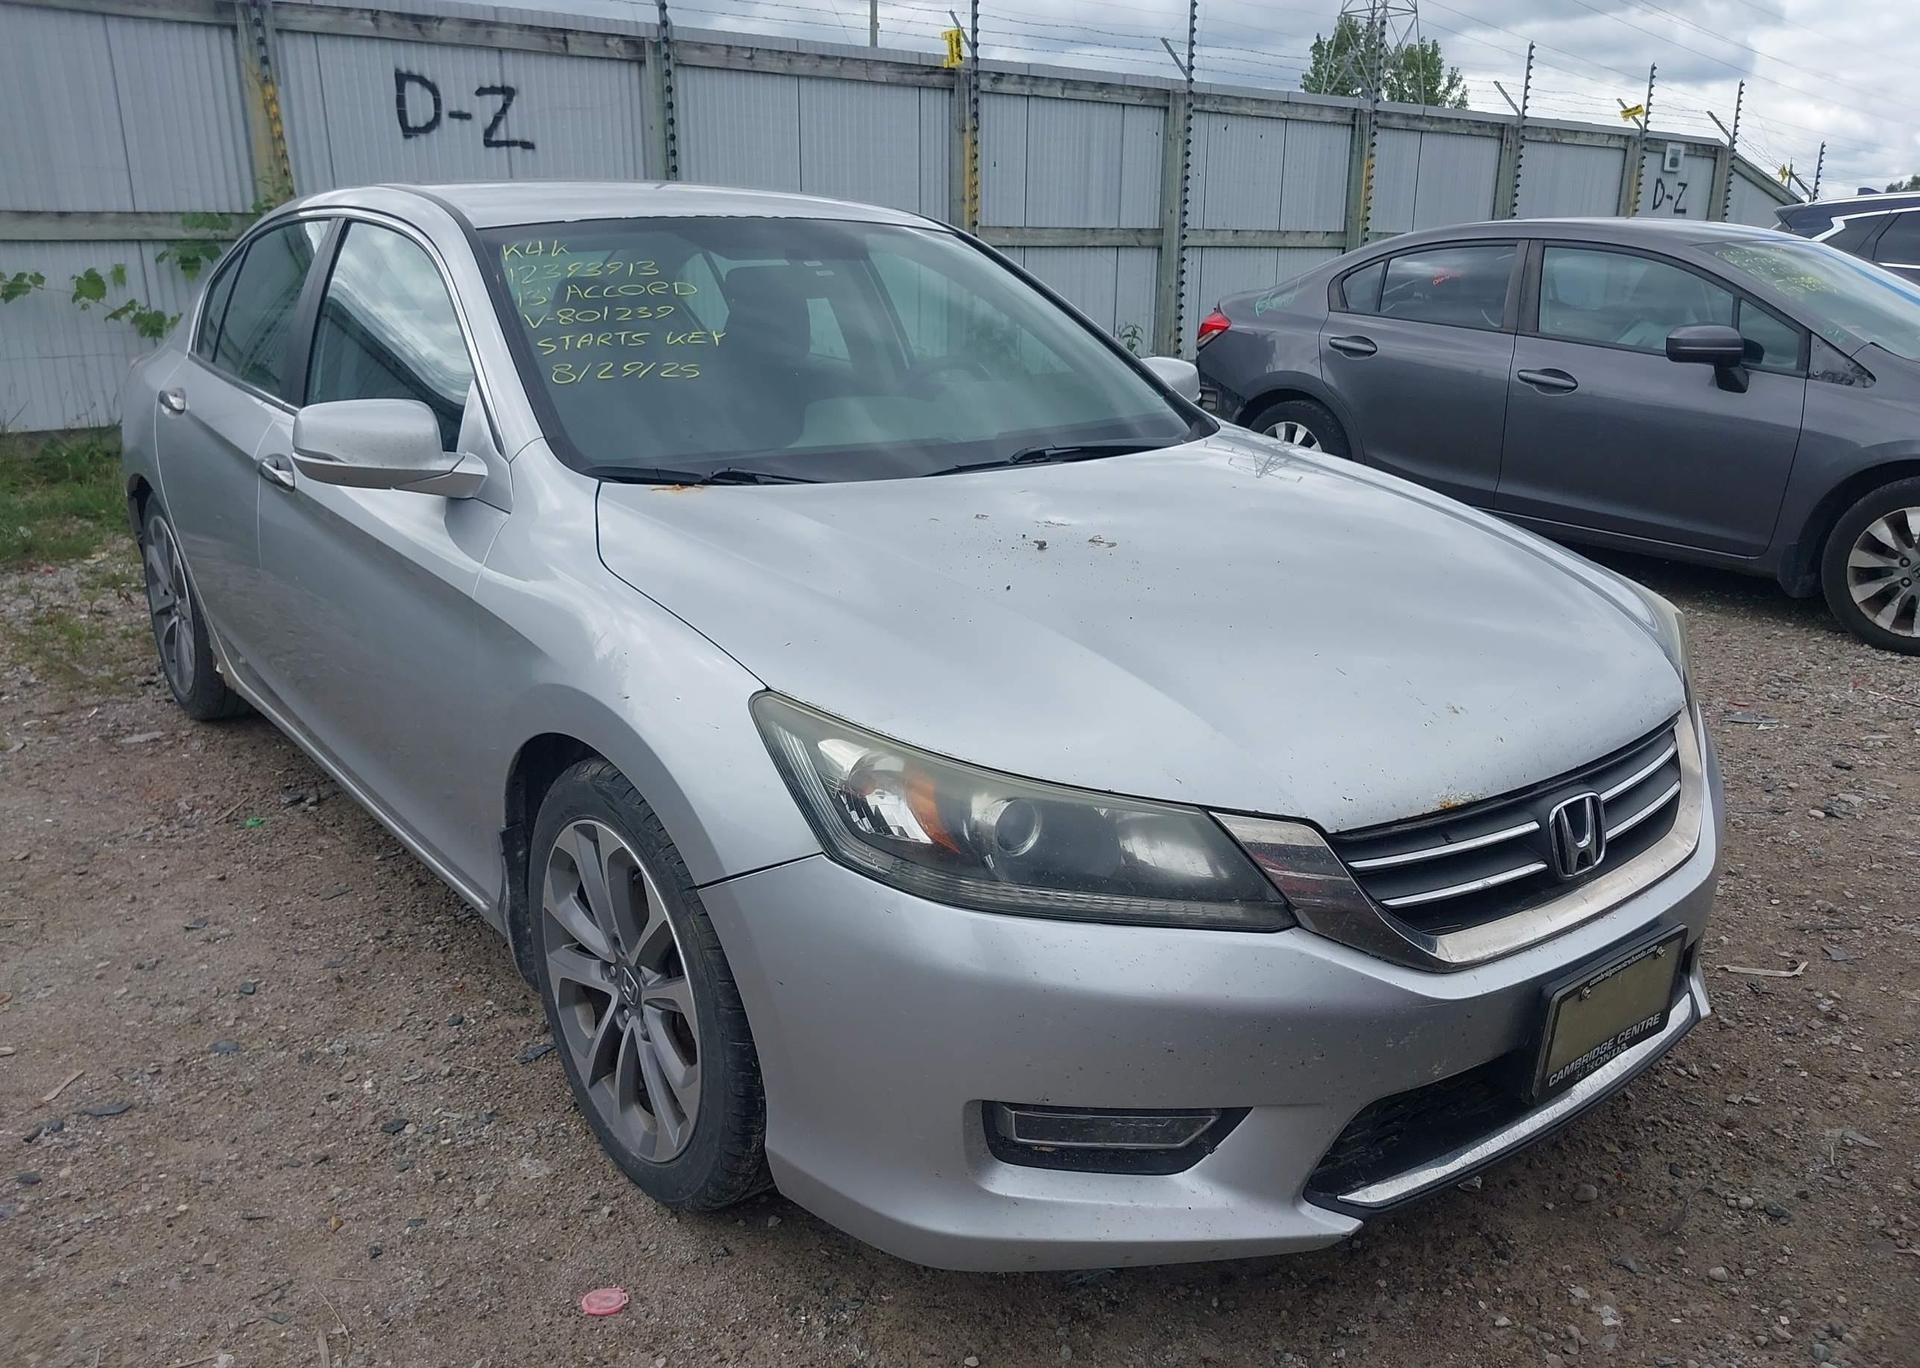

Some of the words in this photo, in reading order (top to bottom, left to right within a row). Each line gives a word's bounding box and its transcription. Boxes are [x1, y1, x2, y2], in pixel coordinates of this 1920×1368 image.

[395, 68, 536, 150] D-Z
[1651, 177, 1688, 214] D-Z
[566, 281, 697, 302] ACCORD
[524, 305, 675, 329] V-801239
[537, 331, 651, 355] STARTS
[666, 331, 727, 347] KEY
[551, 362, 701, 385] 8/29/25
[1548, 1037, 1614, 1087] CAMBRIDGE
[1617, 1012, 1661, 1044] CENTRE
[1585, 1043, 1628, 1073] HONDA
